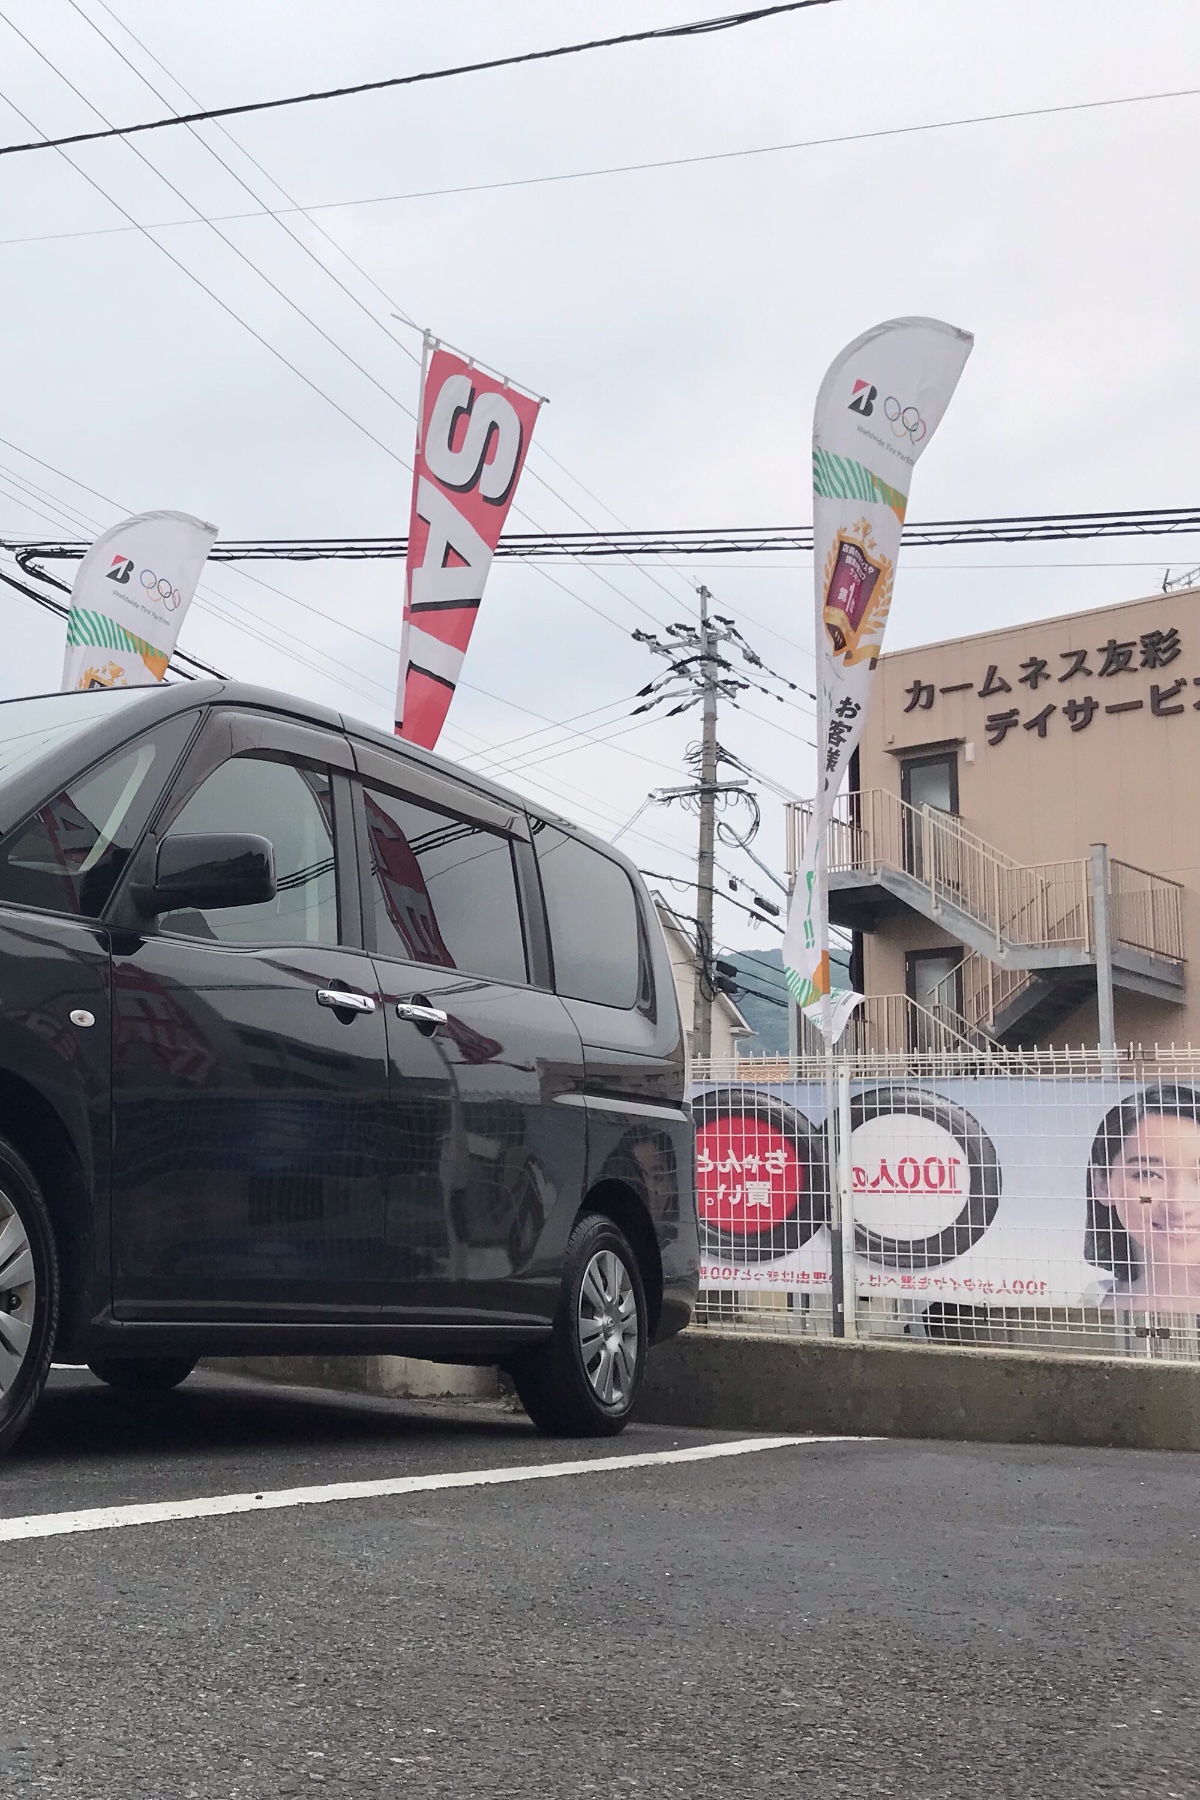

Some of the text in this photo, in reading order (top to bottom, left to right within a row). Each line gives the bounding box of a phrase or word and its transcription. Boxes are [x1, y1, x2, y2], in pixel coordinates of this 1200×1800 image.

[112, 589, 141, 611] Worldwide
[140, 605, 152, 617] Tire
[903, 627, 1182, 713] カームネス友彩
[985, 677, 1200, 746] デイサービ
